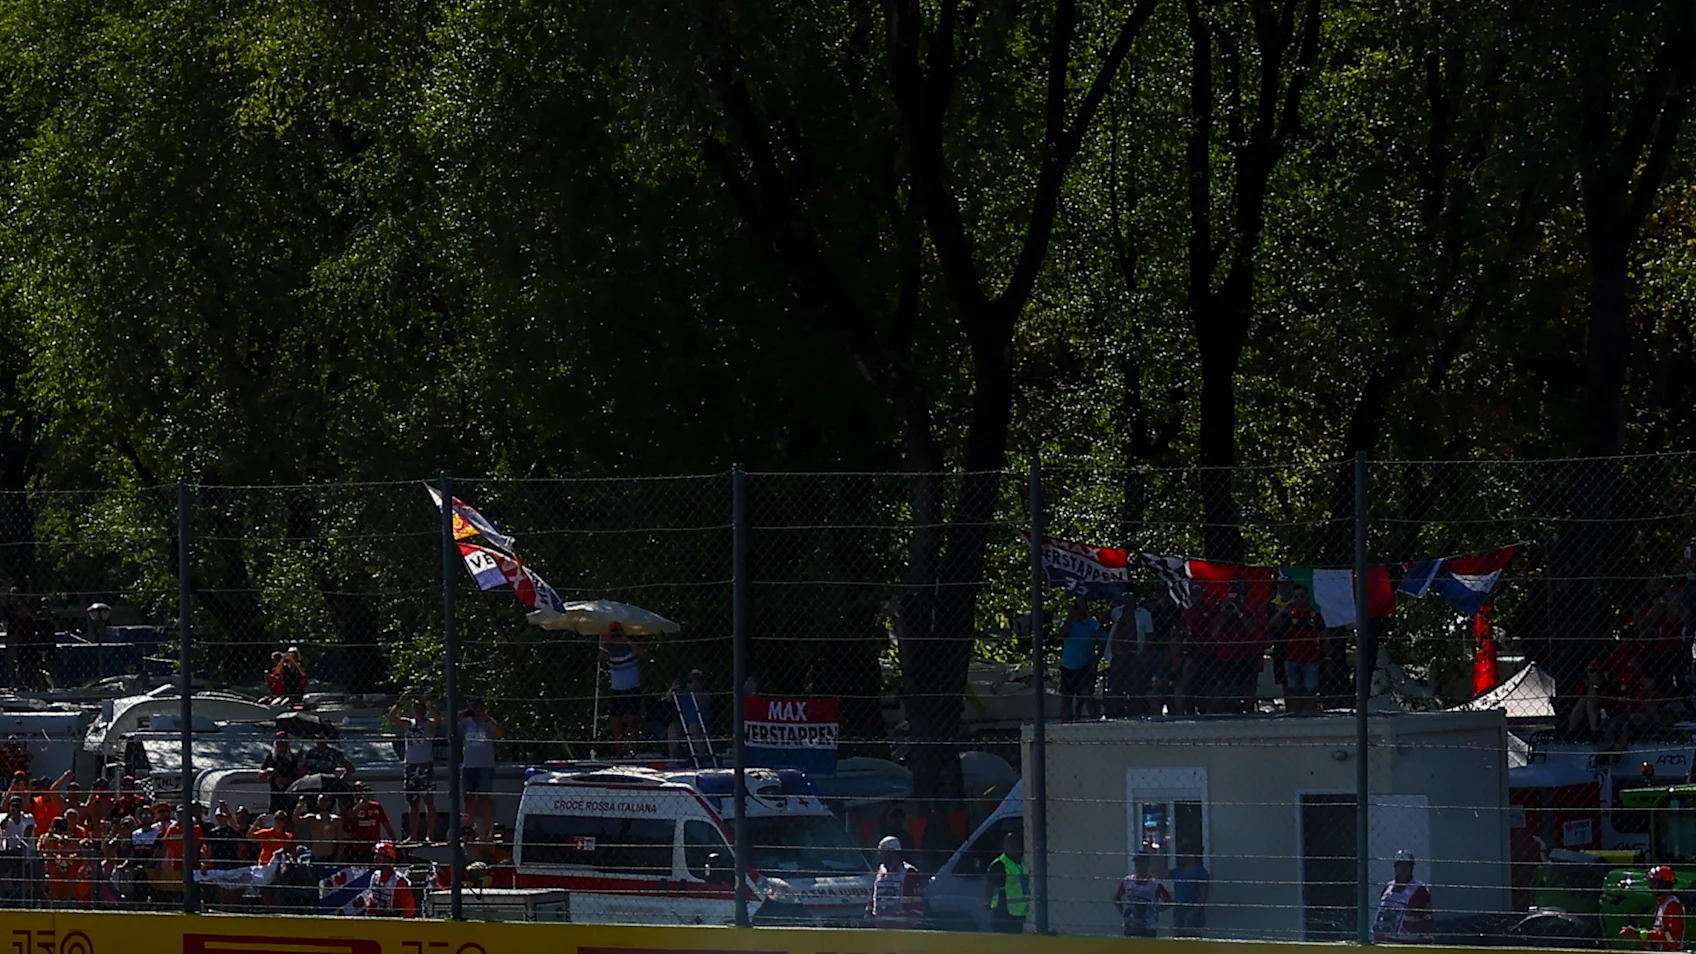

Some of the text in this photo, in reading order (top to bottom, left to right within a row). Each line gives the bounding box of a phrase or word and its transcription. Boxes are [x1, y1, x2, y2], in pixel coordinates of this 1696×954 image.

[1042, 547, 1123, 581] ERSTAPPEN
[768, 701, 808, 721] MAX
[554, 800, 657, 813] CROCE ROSSA ITALIANA
